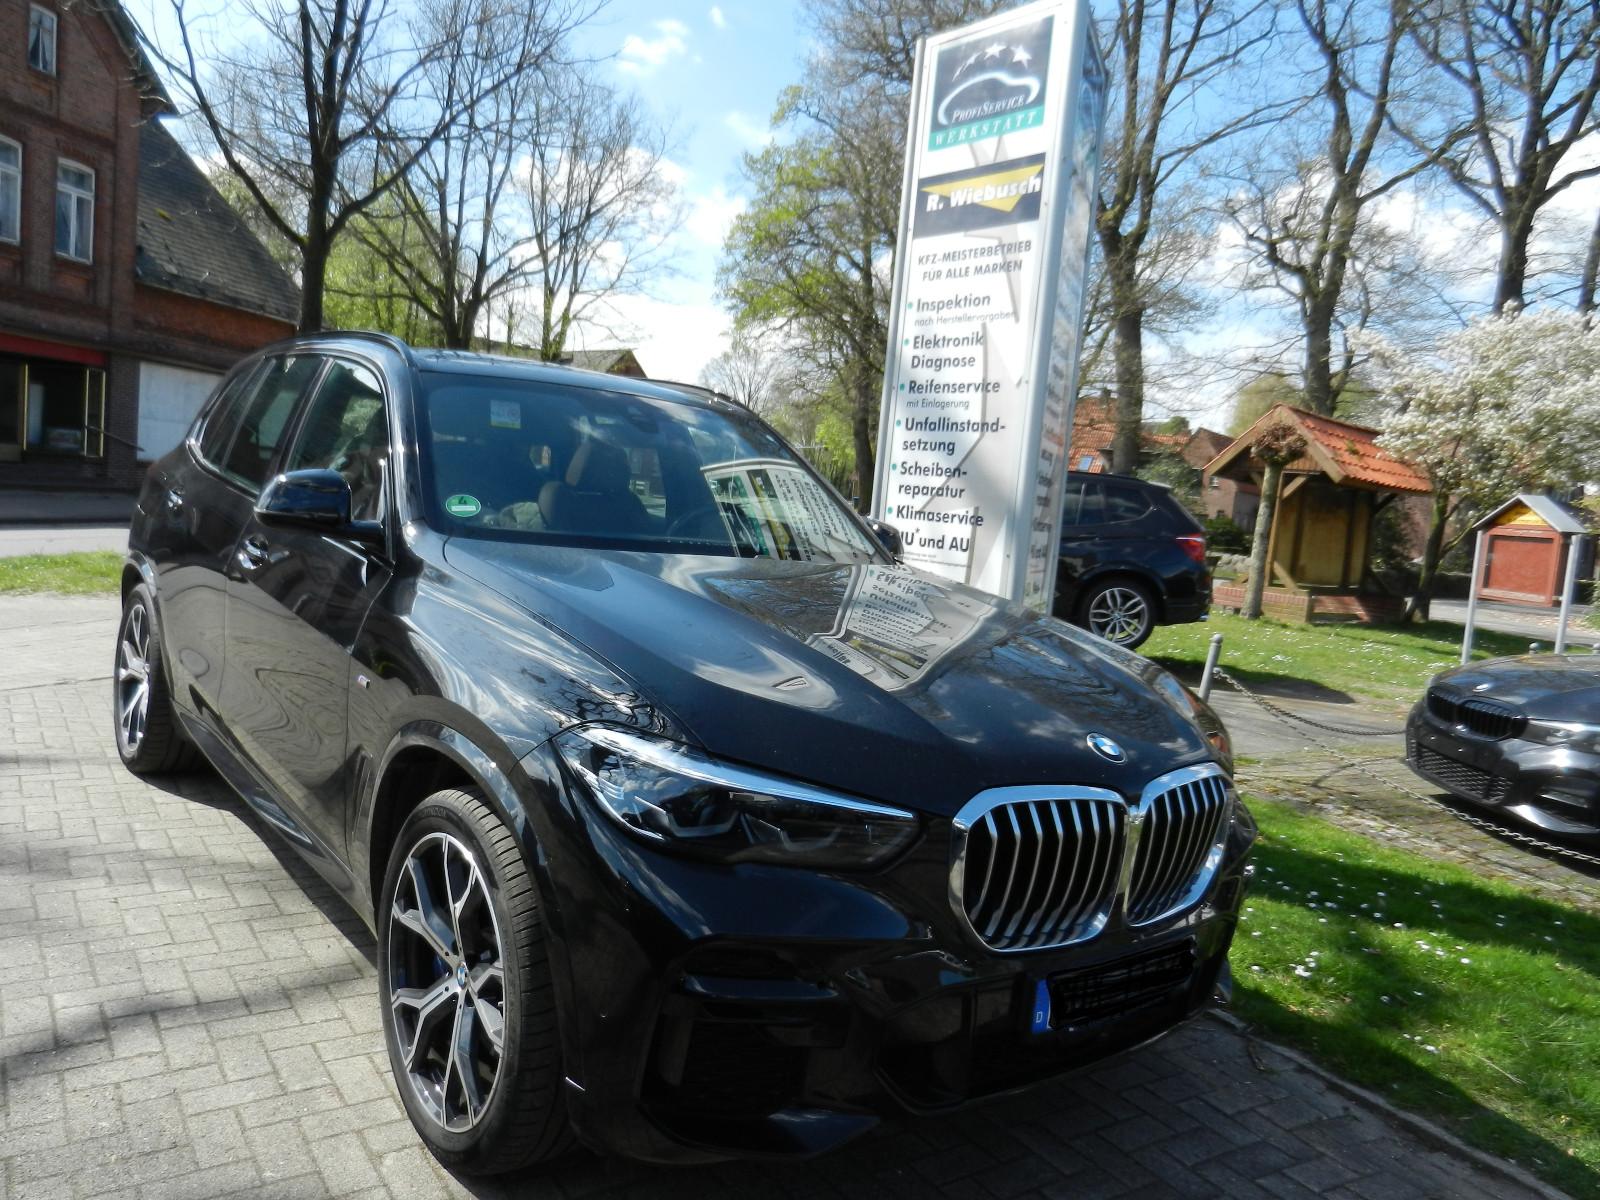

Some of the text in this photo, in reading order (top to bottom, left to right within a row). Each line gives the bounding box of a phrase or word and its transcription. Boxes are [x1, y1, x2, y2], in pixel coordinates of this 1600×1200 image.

[935, 111, 1037, 146] WERKSTATT
[925, 175, 1042, 213] R. Wiebusch
[917, 240, 1032, 266] KFZ-MEISTERBETRIEB
[945, 266, 970, 280] ALLE
[973, 259, 1023, 277] MARKEN
[916, 293, 991, 315] Inspektion
[914, 316, 934, 327] nach
[912, 331, 985, 350] Elektronik
[911, 355, 976, 372] Diagnose
[908, 379, 1001, 394] Reifenservice
[906, 399, 970, 411] mit Einlagerung
[904, 416, 1007, 433] Unfallinstand-
[902, 439, 956, 456] setzung
[900, 461, 968, 479] Scheiben-
[898, 484, 966, 499] reparatur
[896, 505, 985, 527] Klimaservice
[919, 535, 945, 550] und
[949, 537, 971, 553] AU
